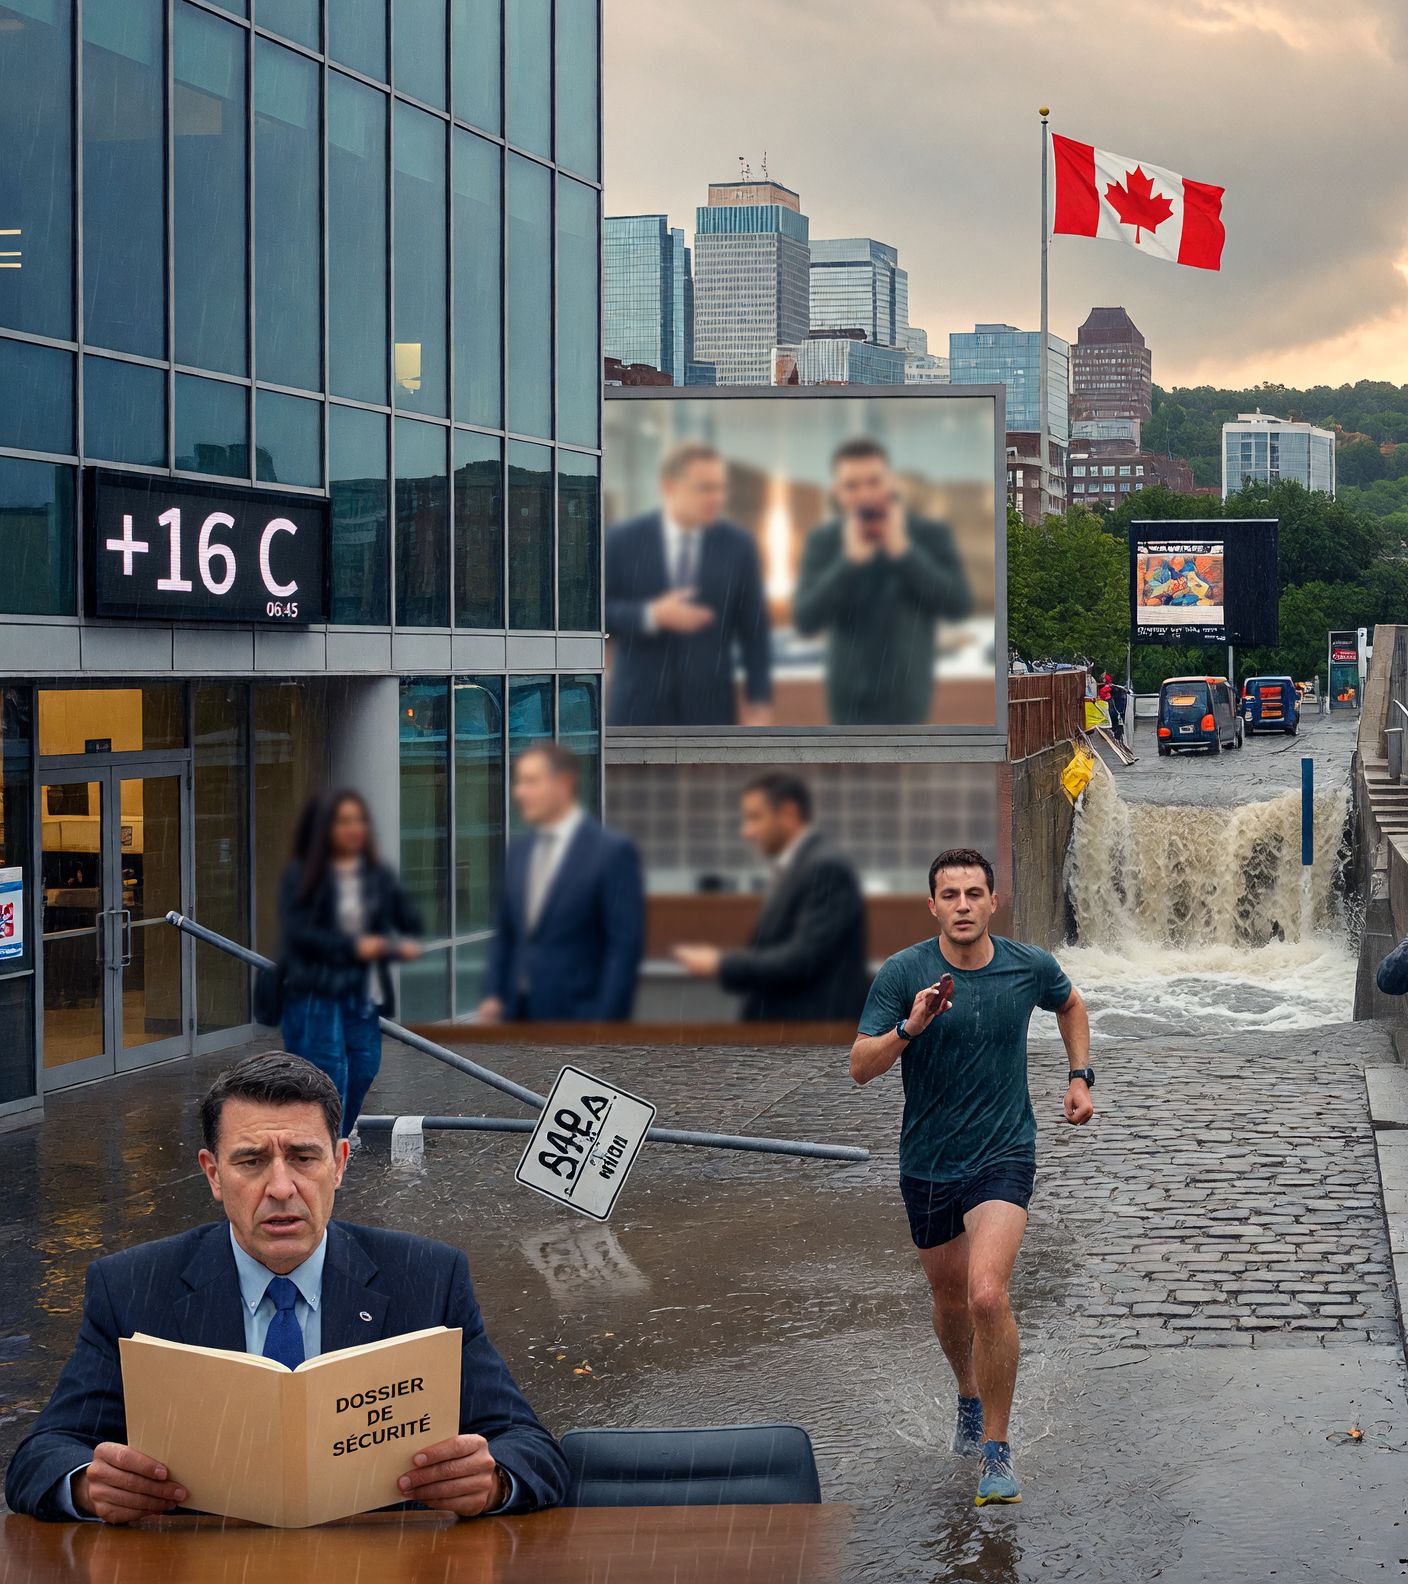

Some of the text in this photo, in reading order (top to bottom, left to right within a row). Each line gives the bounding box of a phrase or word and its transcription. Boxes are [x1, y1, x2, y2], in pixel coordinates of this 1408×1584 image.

[106, 508, 298, 597] +16 C
[266, 602, 299, 618] 06:45
[336, 1377, 424, 1413] DOSSIER
[367, 1405, 393, 1427] DE
[332, 1413, 431, 1457] SÉCURITÉ
